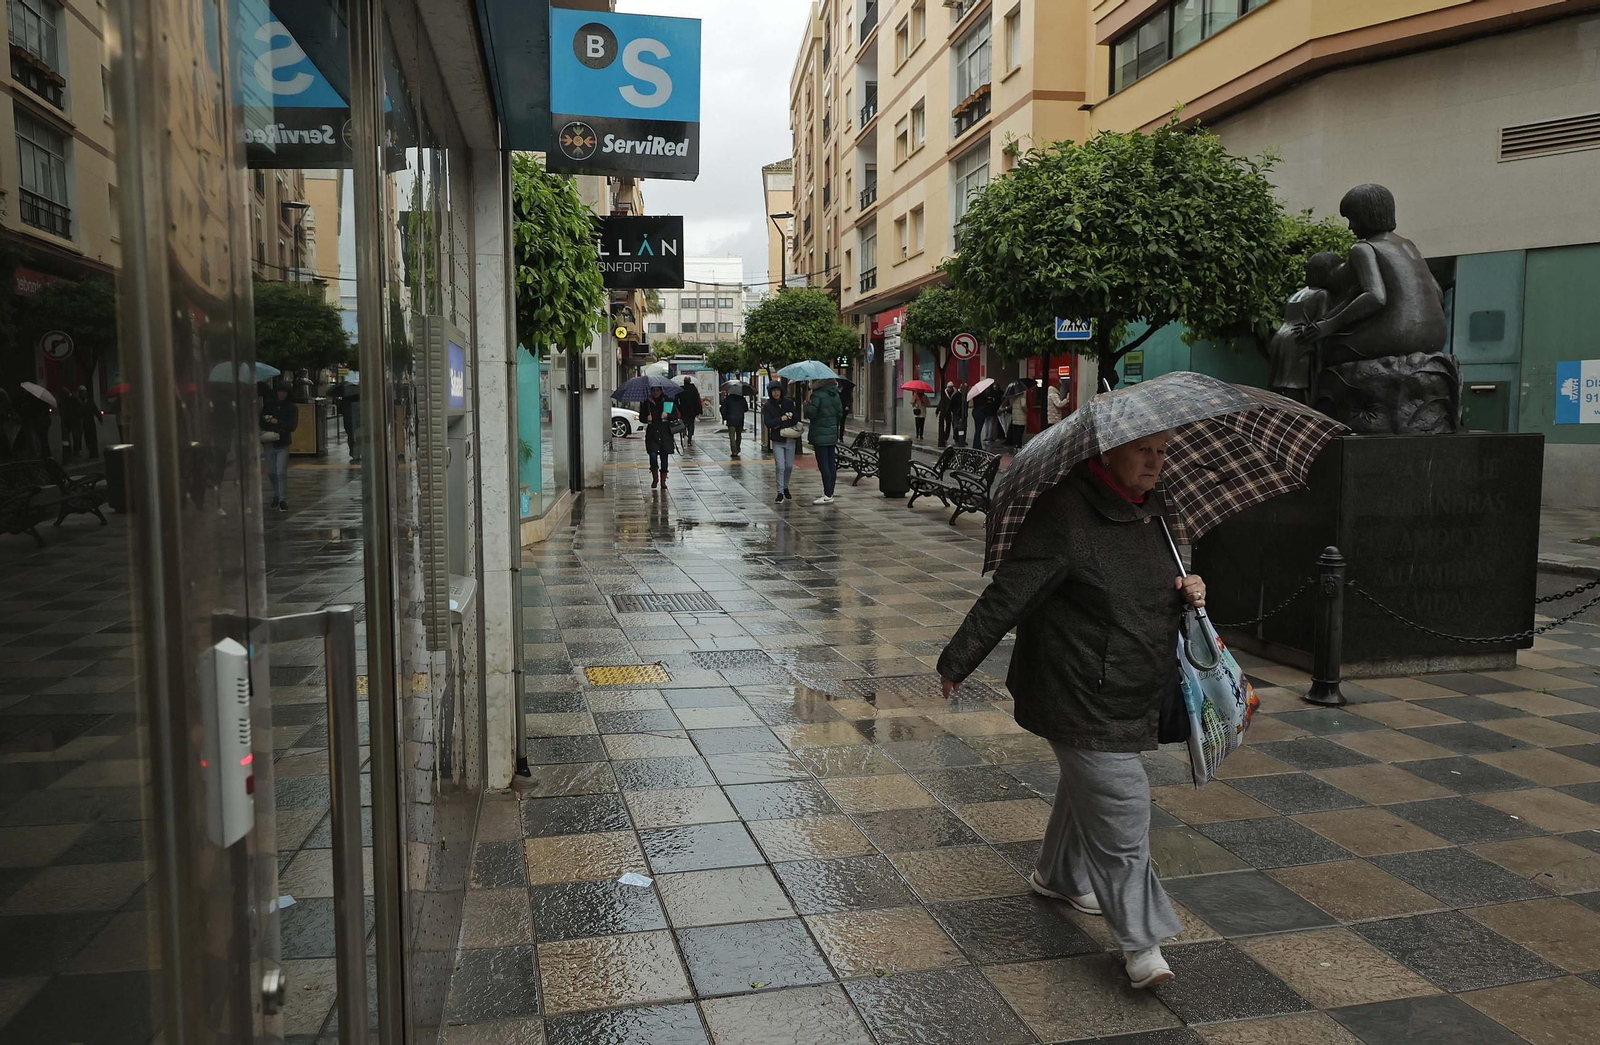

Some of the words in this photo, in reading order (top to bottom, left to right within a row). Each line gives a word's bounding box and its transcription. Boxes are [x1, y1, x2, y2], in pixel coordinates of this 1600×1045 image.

[586, 34, 605, 58] B
[619, 37, 673, 108] S
[602, 133, 690, 157] ServiRed
[595, 261, 649, 273] ONFORT
